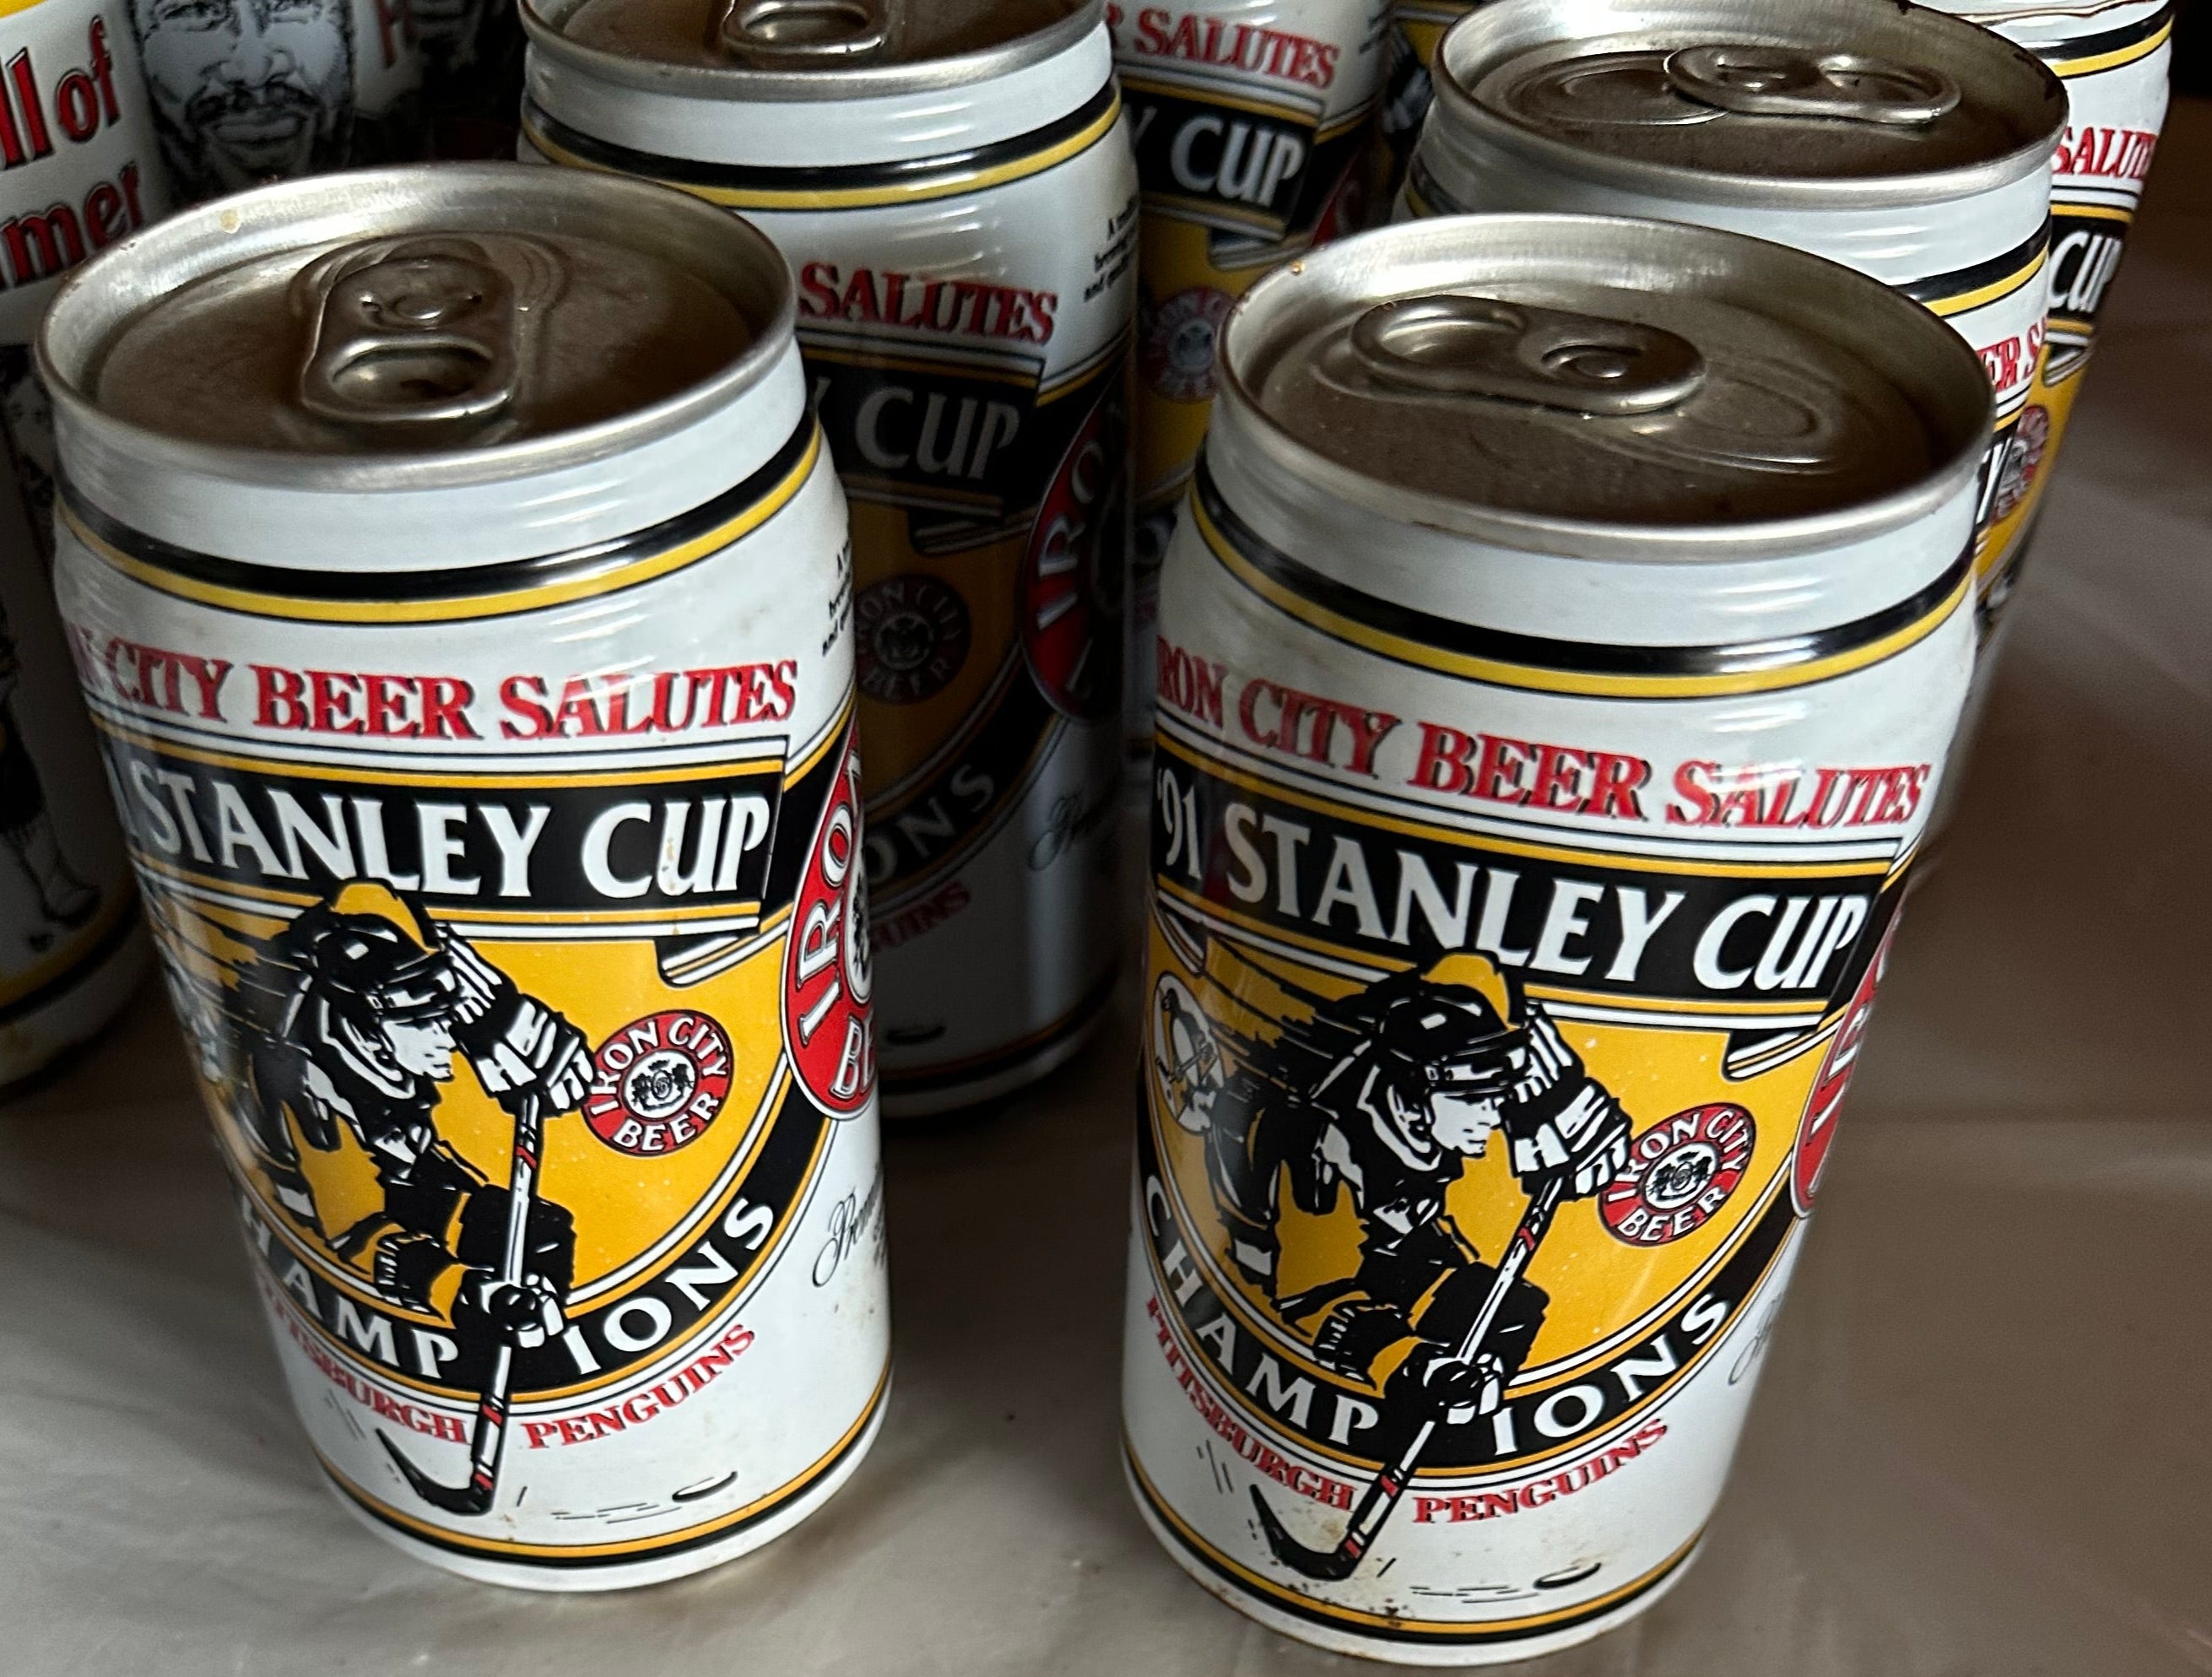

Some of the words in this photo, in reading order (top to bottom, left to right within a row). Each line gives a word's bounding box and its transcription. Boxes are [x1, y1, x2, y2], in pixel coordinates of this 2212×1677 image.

[56, 15, 121, 143] of
[1134, 8, 1340, 89] SALUTES
[1170, 111, 1307, 208] CUP
[0, 160, 145, 291] mer
[798, 262, 1057, 346] SALUTES
[854, 385, 1021, 481] CUP
[104, 636, 234, 724] CITY
[248, 663, 483, 740] BEER
[499, 659, 798, 741] SALUTES
[1238, 678, 1402, 780] CITY
[1407, 720, 1652, 823] BEER
[1665, 760, 1931, 830] SALUTES
[130, 759, 551, 897] STANLEY
[581, 794, 770, 901] CUP
[1222, 803, 1686, 982] STANLEY
[1692, 890, 1869, 990] CUP
[590, 1020, 659, 1116] IRON
[668, 1016, 727, 1077] CITY
[613, 1092, 719, 1151] BEER
[1607, 1112, 1701, 1203] IRON
[1706, 1109, 1750, 1171] CITY
[1616, 1186, 1727, 1242] BEER
[520, 1323, 756, 1449] PENGUINS
[1146, 1296, 1359, 1513] PITTSBURGH
[1413, 1418, 1668, 1524] PENGUINS
